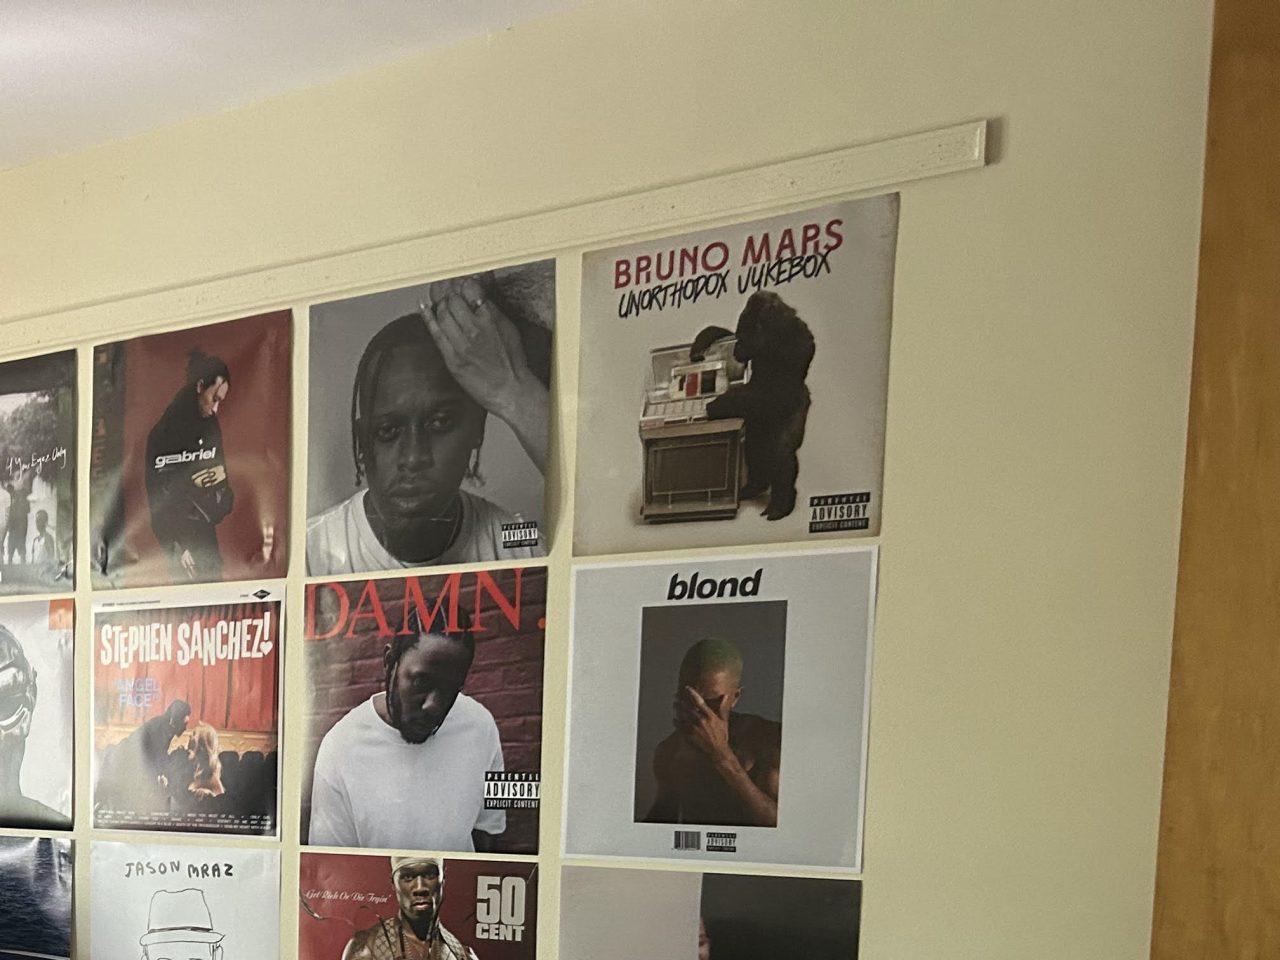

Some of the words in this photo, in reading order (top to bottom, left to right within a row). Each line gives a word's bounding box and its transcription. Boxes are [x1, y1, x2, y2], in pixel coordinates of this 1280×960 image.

[614, 241, 729, 289] BRUNO
[741, 218, 844, 267] MARS
[618, 269, 731, 319] UNORTHODOX
[737, 249, 832, 294] JUKEBOX
[154, 440, 217, 469] gabriel
[811, 504, 868, 521] ADVISORY
[667, 567, 763, 601] blond
[304, 567, 546, 641] DAMN.
[100, 622, 173, 669] STEPHEN
[177, 611, 273, 667] SANCHEZ!
[486, 782, 540, 798] ADVISORY
[487, 773, 538, 781] PARENTAL
[124, 860, 181, 878] JASON
[188, 863, 234, 878] MRAZ
[476, 875, 526, 926] 50
[475, 922, 526, 942] CENT
